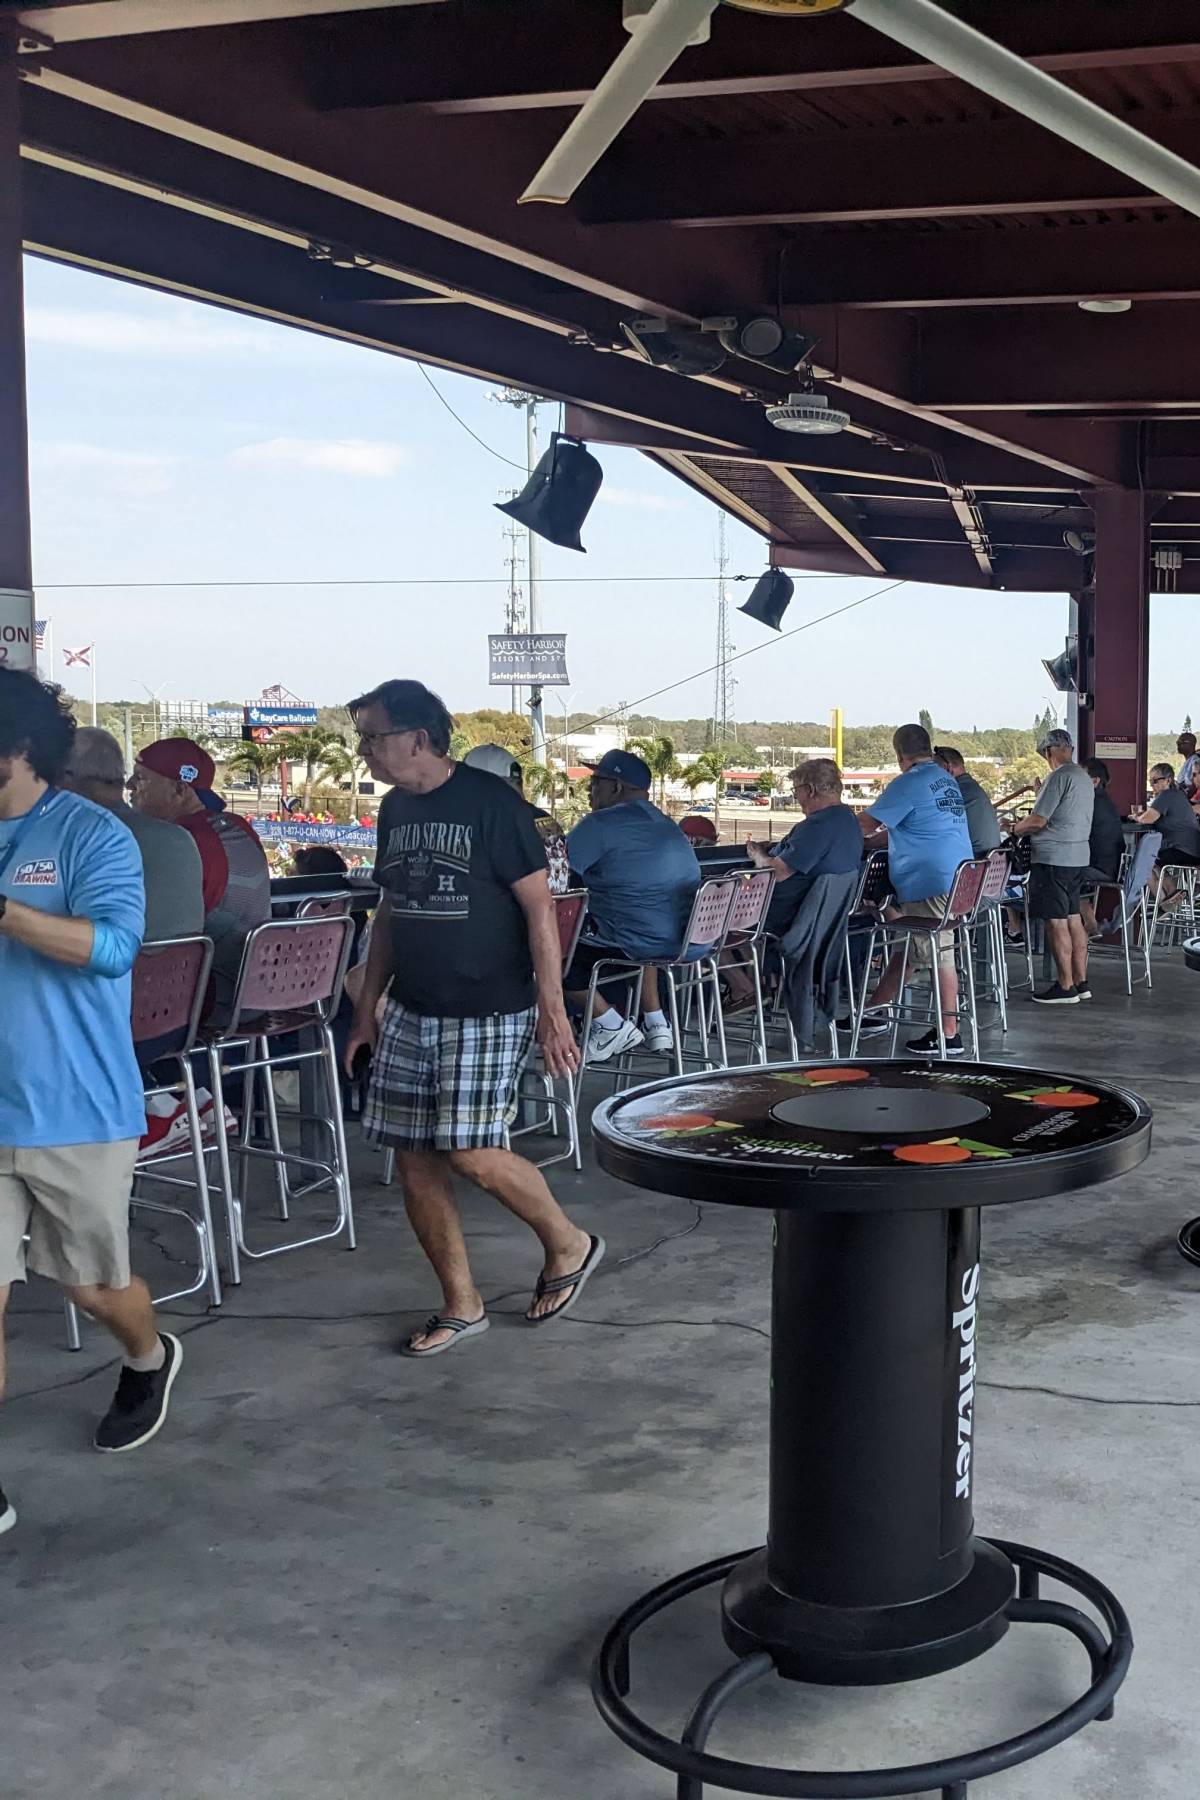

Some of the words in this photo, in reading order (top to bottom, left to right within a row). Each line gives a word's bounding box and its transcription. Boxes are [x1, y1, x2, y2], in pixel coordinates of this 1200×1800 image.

[260, 713, 288, 724] BayCare
[289, 713, 317, 723] Ballpark
[386, 823, 420, 856] WORLD
[422, 822, 473, 860] SERIES
[20, 861, 54, 874] 50/50
[437, 874, 456, 891] H
[732, 1143, 854, 1160] Spritzer
[952, 1262, 980, 1499] Spritzer
